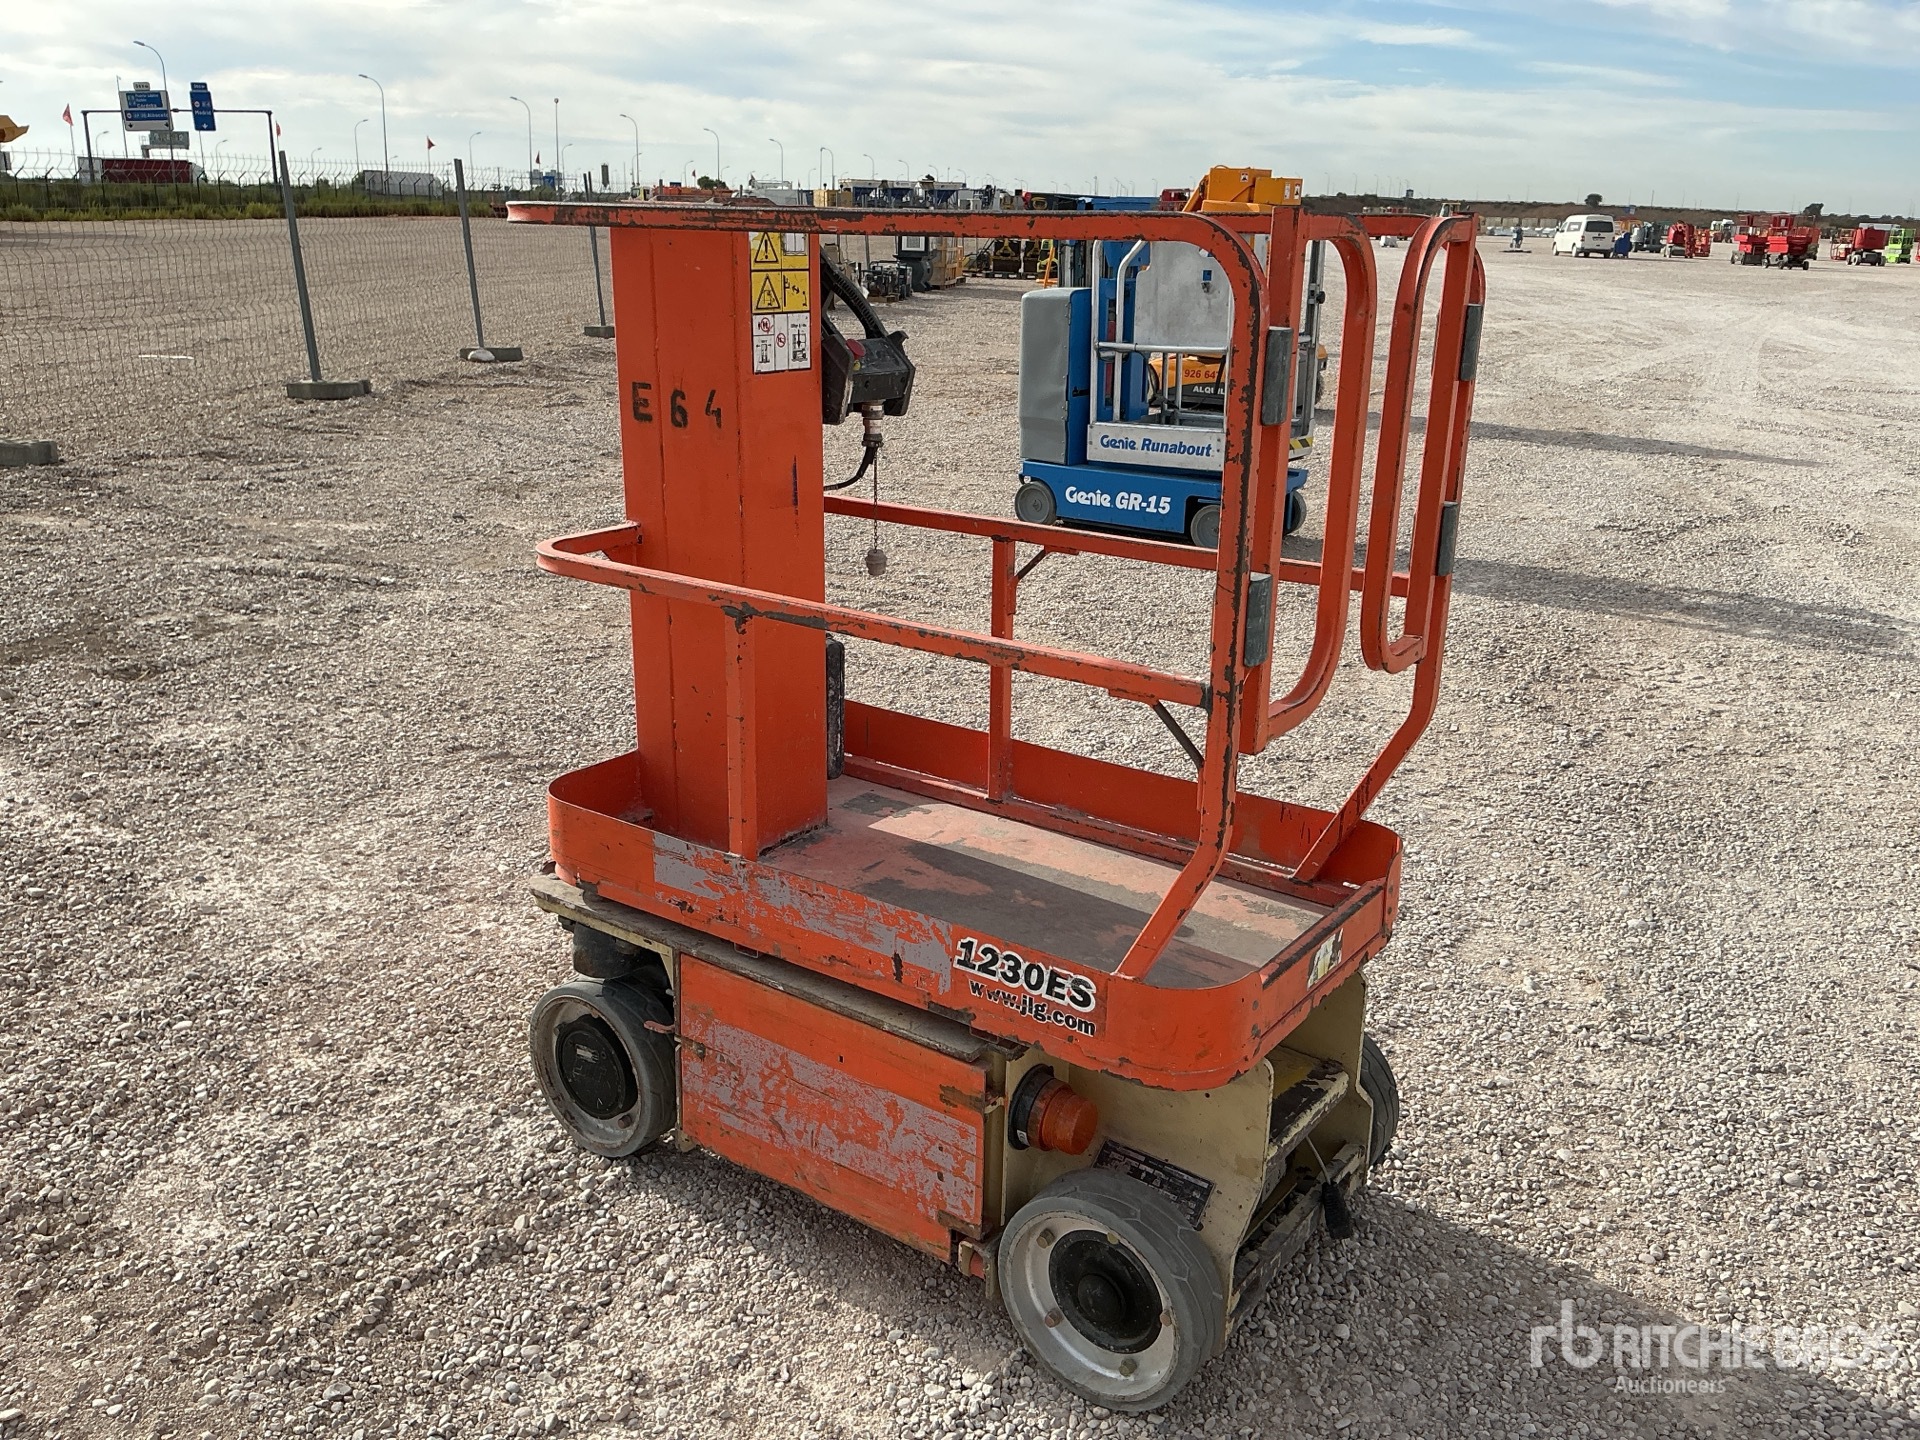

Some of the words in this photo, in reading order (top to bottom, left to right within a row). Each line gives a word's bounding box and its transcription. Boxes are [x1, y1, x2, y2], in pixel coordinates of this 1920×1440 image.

[1184, 369, 1202, 379] 926
[1100, 435, 1137, 451] Genie
[1140, 438, 1212, 457] Runabout
[1065, 485, 1112, 508] Genie
[1115, 491, 1172, 515] GR-15
[955, 938, 1095, 1011] 1230ES
[969, 979, 1097, 1037] www.jlg.com
